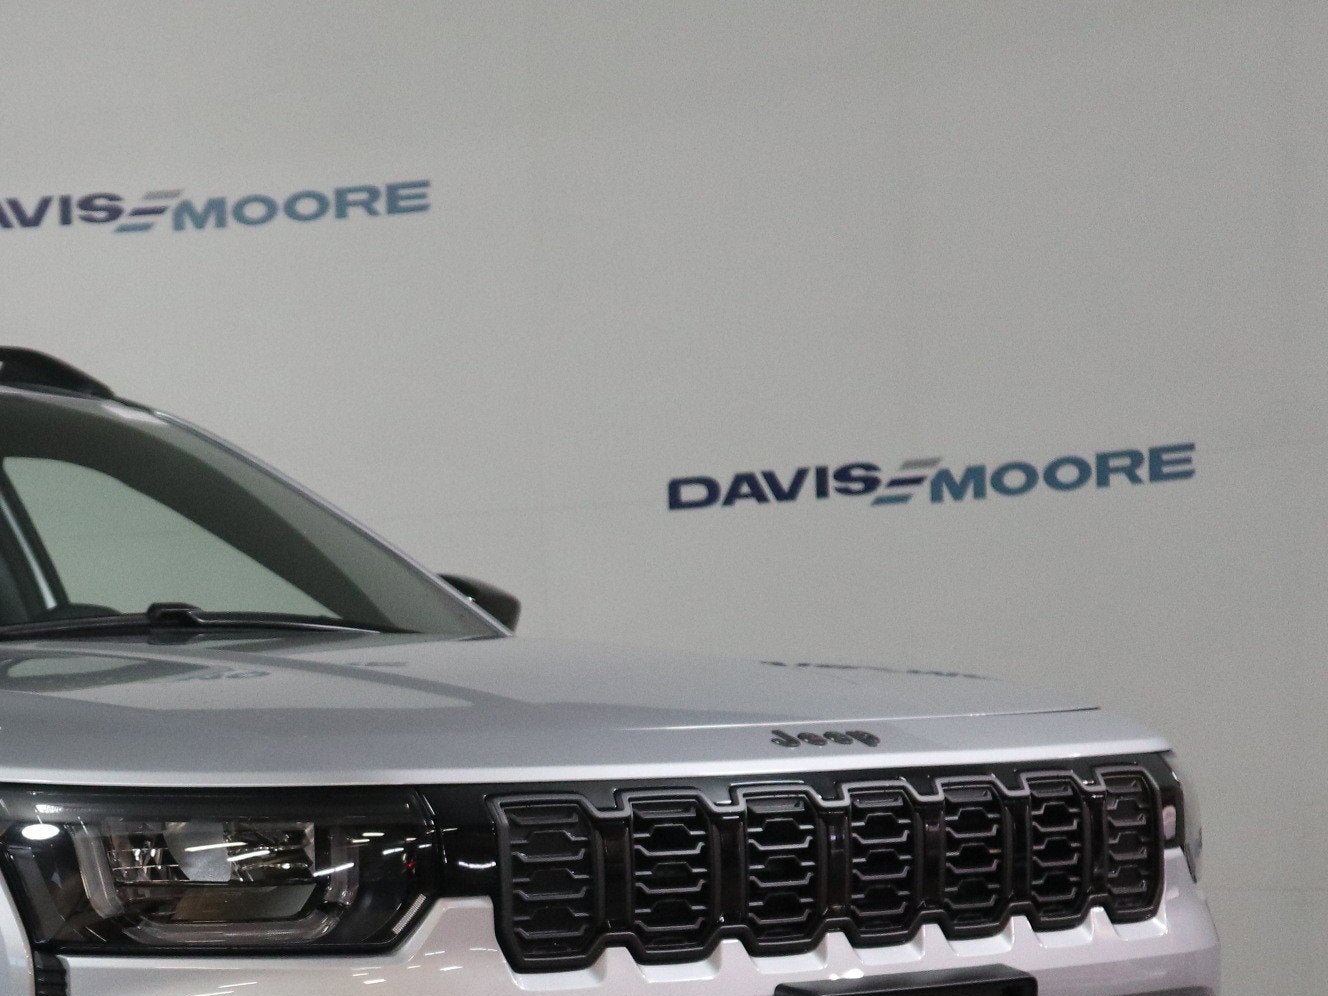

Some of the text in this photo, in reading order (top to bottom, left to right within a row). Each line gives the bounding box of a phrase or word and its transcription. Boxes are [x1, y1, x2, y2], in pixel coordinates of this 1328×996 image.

[173, 180, 431, 231] MOORE
[667, 442, 1196, 511] DAVIS MOORE
[771, 729, 881, 748] Jeep
